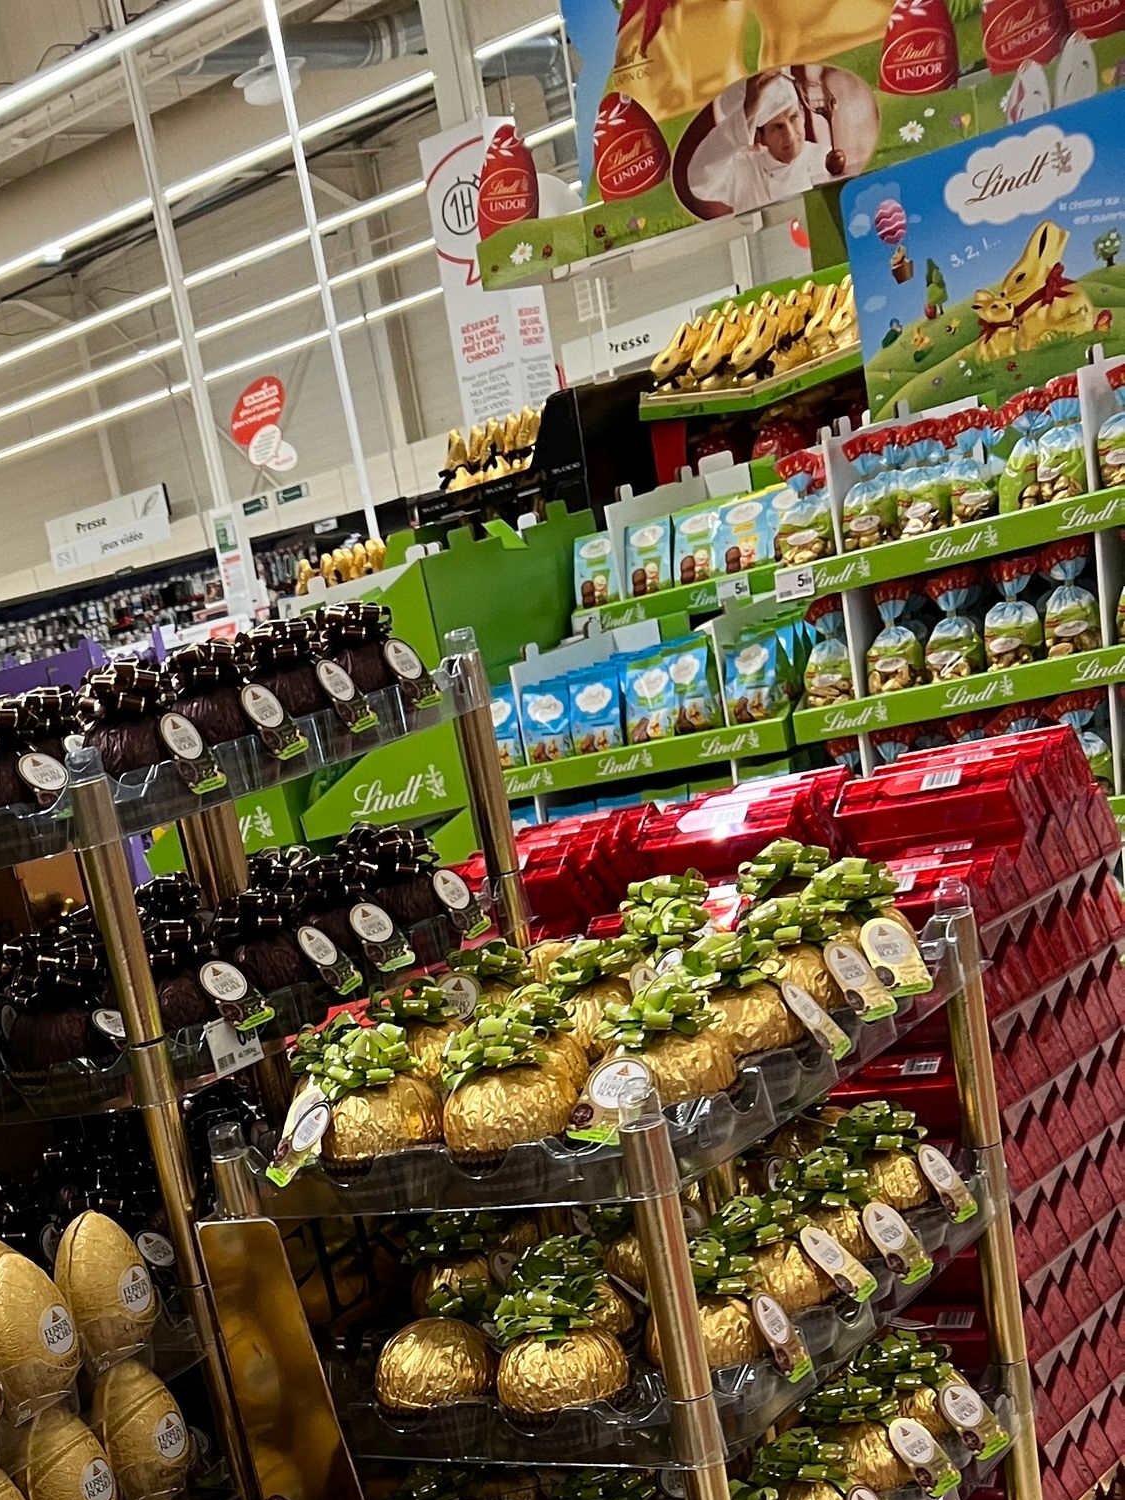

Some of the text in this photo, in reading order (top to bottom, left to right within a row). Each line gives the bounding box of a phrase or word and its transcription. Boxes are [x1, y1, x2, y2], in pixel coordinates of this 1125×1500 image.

[895, 63, 943, 81] LINDOR
[612, 155, 656, 185] LINDOR
[965, 151, 1052, 206] Lindt
[489, 198, 526, 213] LINDOR
[76, 517, 108, 534] Presse
[1056, 498, 1119, 531] Lindt
[926, 531, 983, 562] Lindt
[942, 681, 1001, 710] Lindt
[820, 704, 880, 733] Lindt
[699, 734, 748, 758] Lindt
[596, 753, 641, 777] Lindt
[351, 773, 424, 818] Lindt
